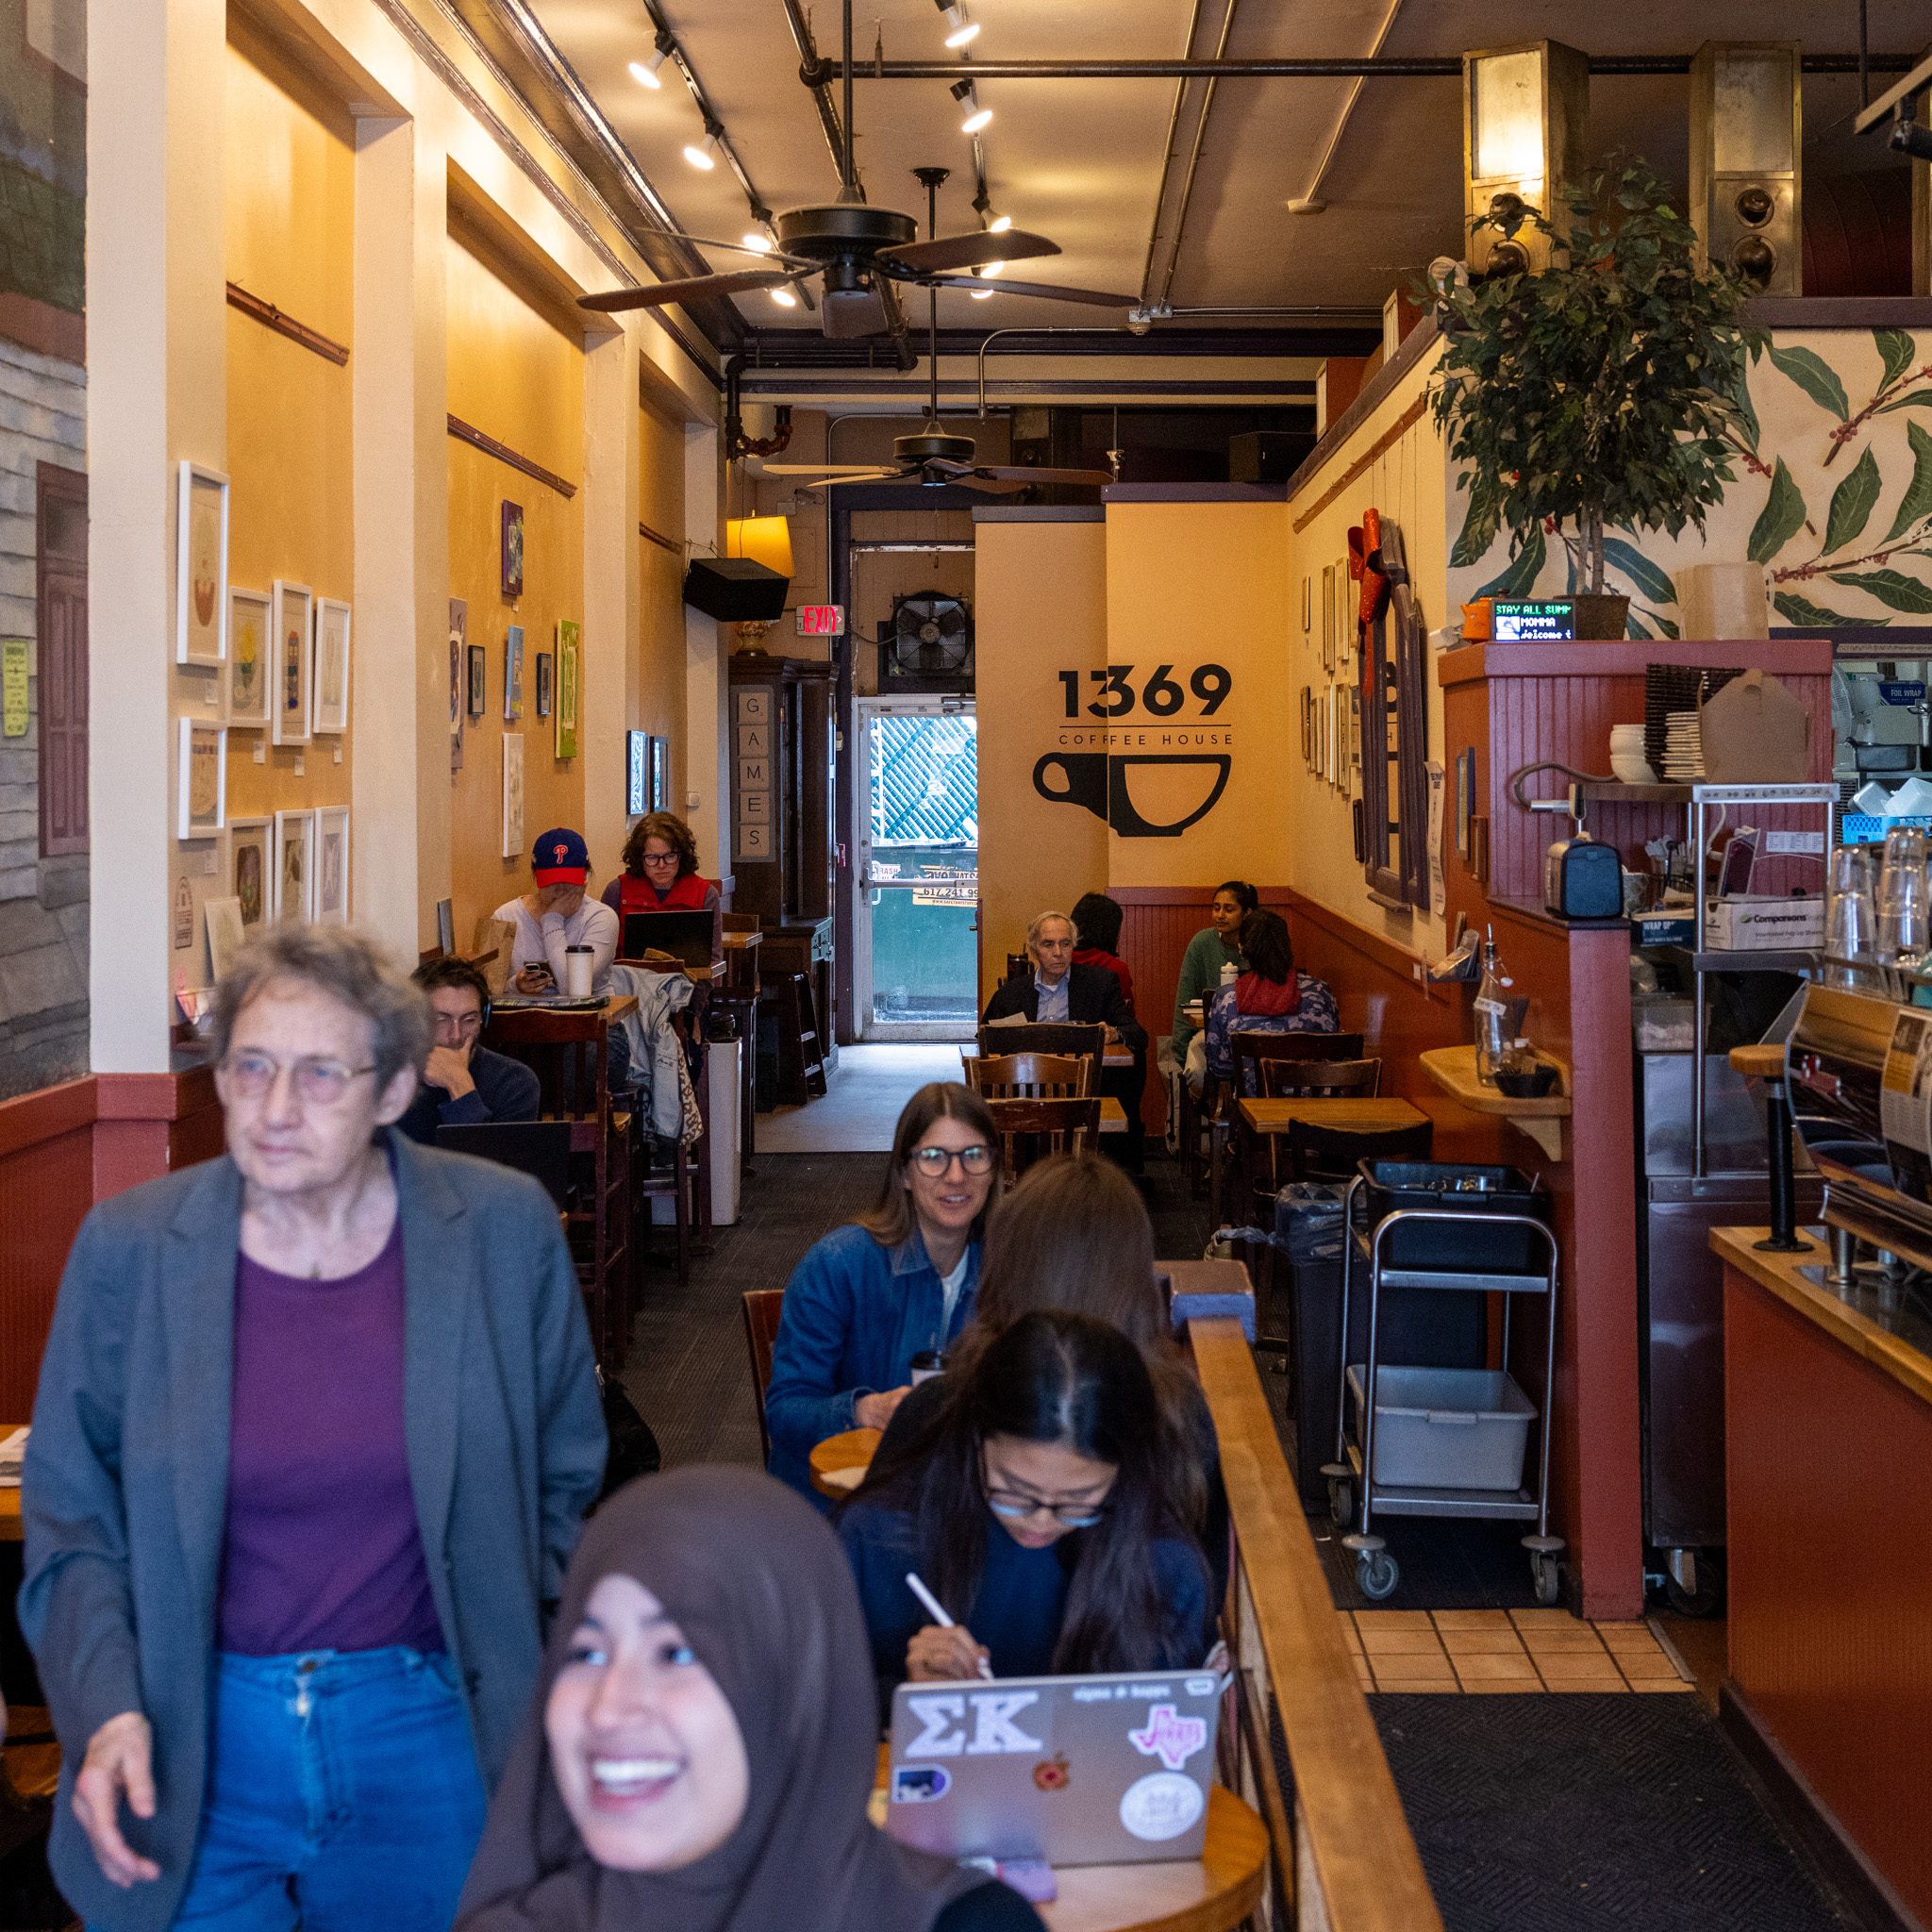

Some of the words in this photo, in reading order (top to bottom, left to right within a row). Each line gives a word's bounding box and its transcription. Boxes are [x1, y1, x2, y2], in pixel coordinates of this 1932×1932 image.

[804, 606, 839, 633] EXIT
[1496, 606, 1520, 614] STAY
[1524, 606, 1541, 614] ALL
[1521, 617, 1556, 626] MOMMA
[1058, 663, 1232, 718] 1369
[1162, 734, 1232, 745] HOUSE
[746, 697, 763, 847] GAMES
[553, 844, 569, 864] P
